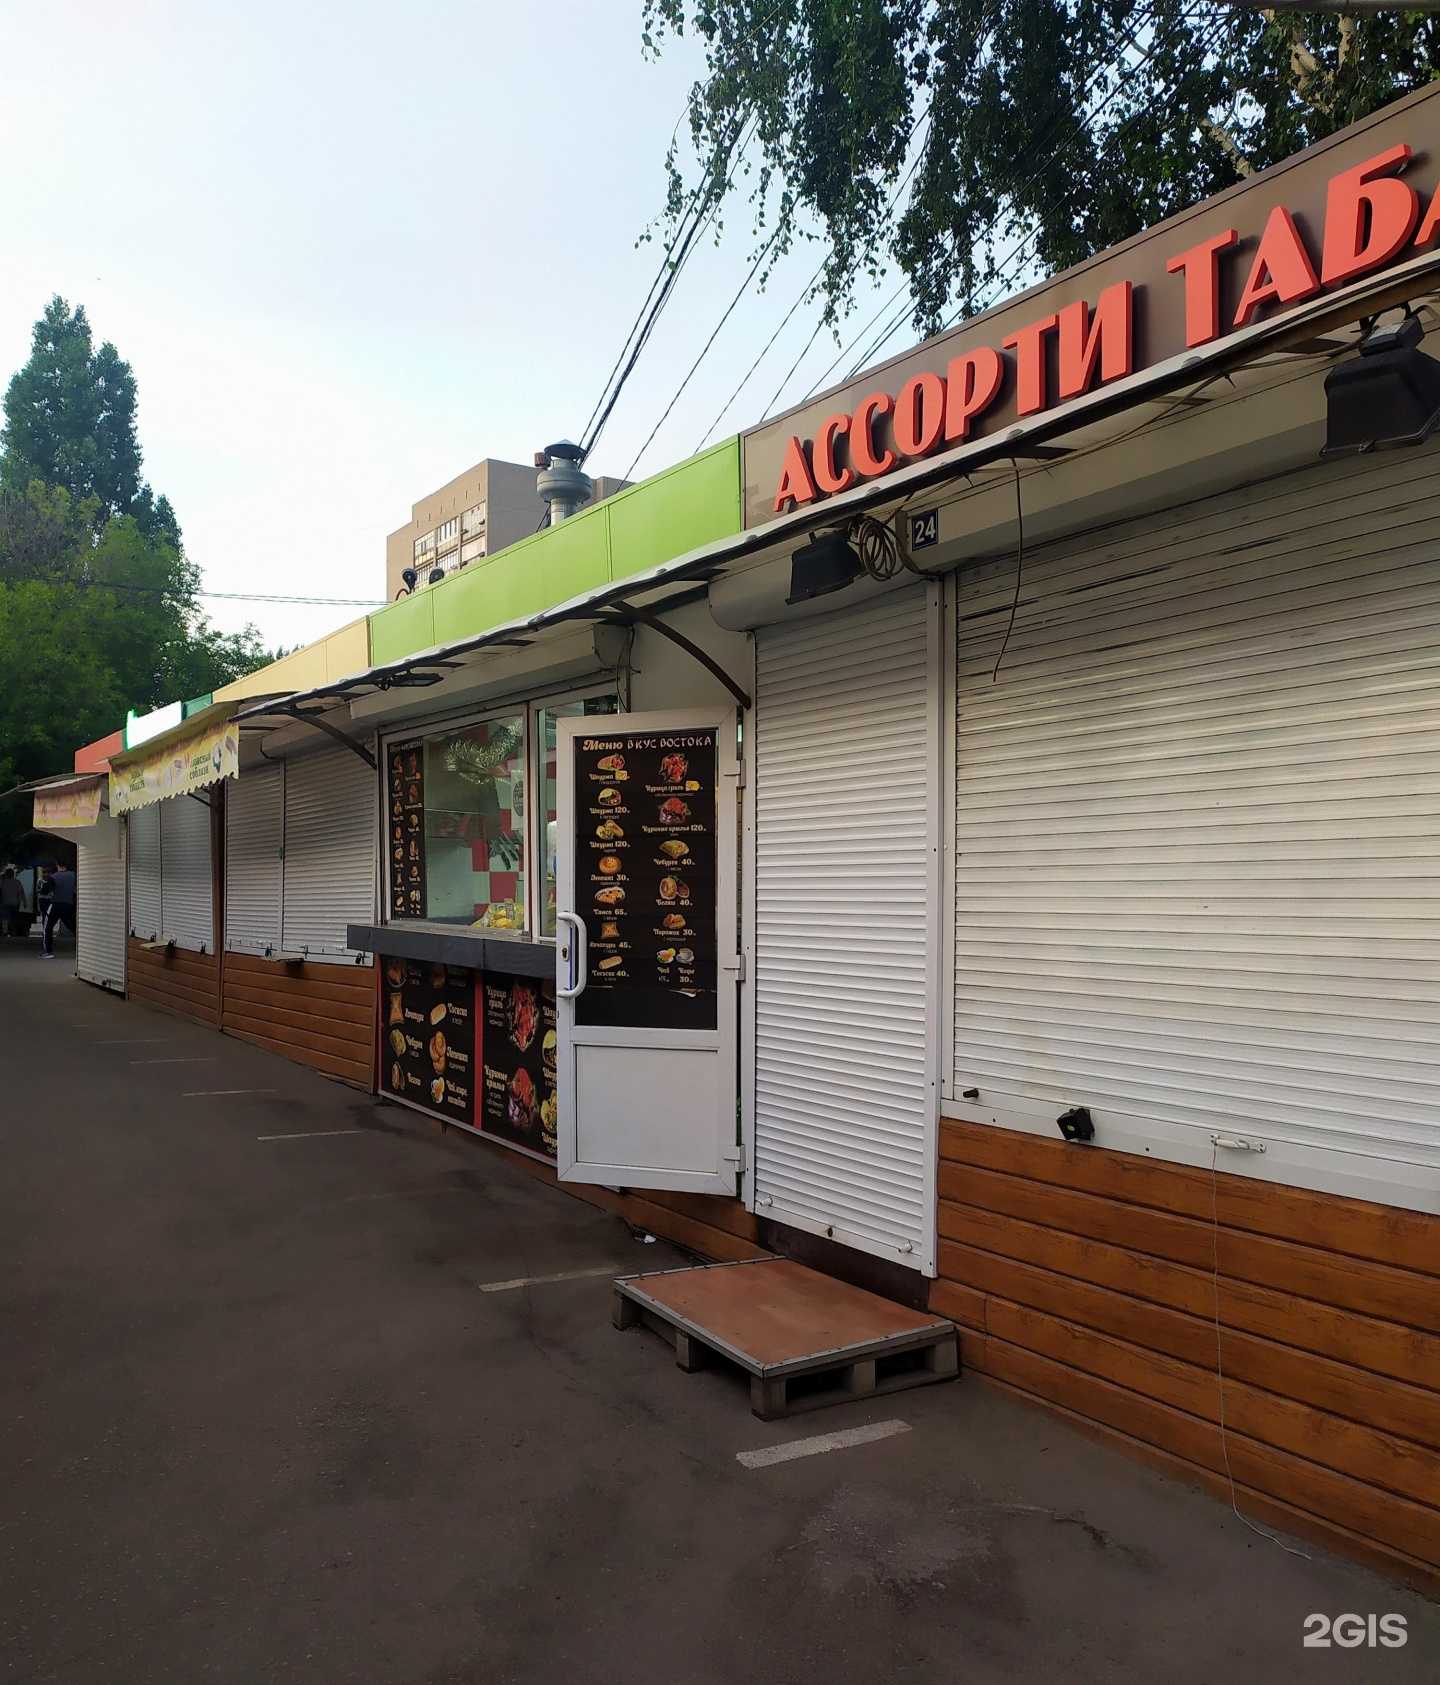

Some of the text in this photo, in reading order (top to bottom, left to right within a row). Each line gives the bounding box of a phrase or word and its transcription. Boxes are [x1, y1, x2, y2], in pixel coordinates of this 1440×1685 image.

[774, 280, 1132, 513] АССОРТИ
[915, 516, 936, 543] 24
[583, 736, 712, 751] Меню ВКУС ВОСТОКА
